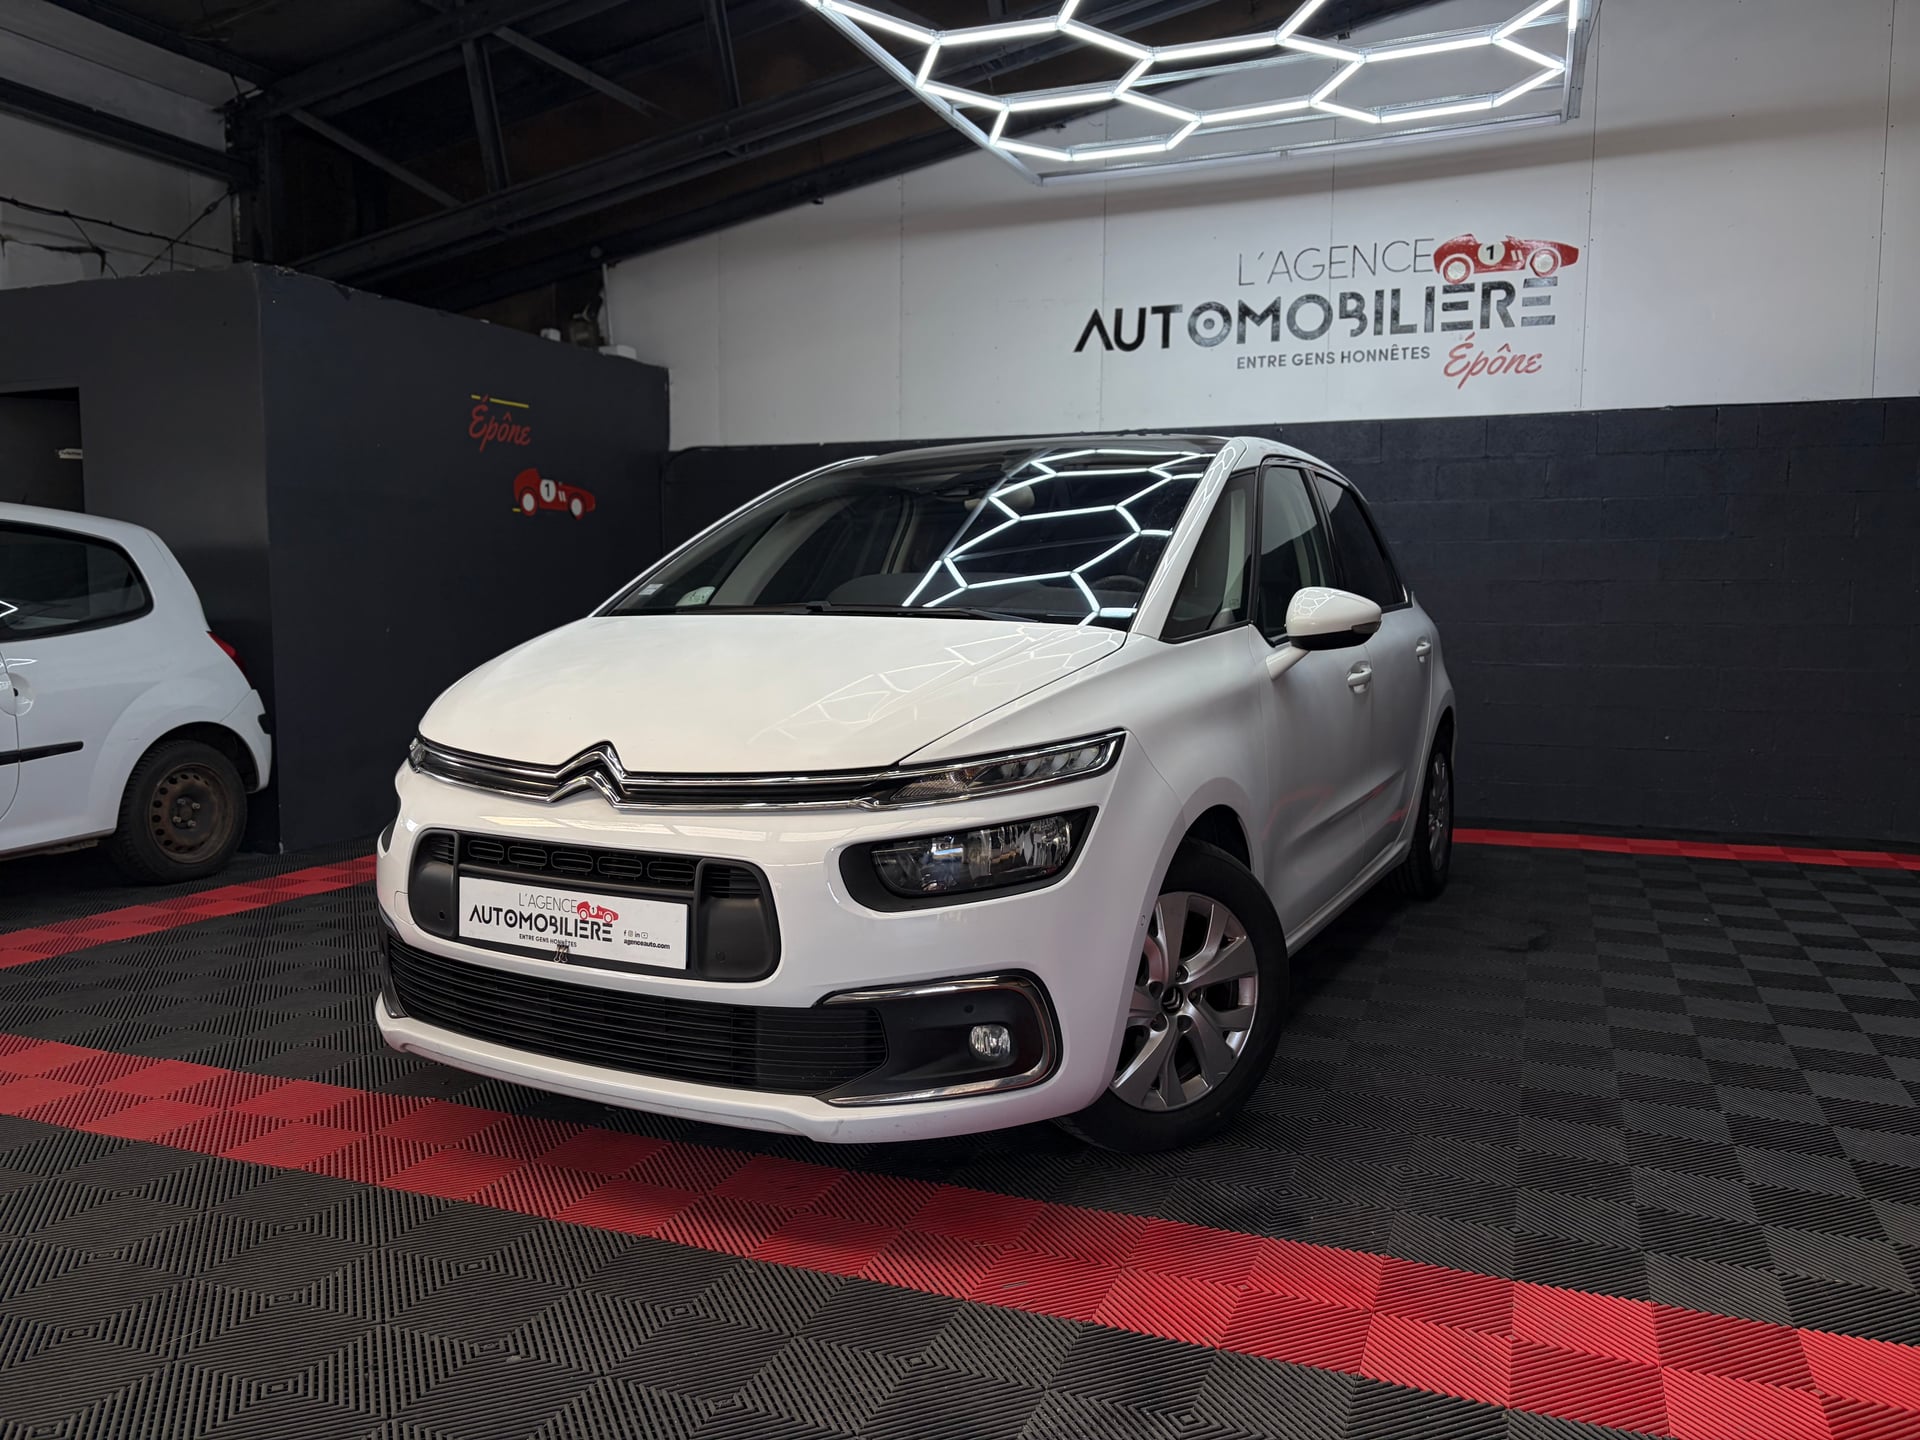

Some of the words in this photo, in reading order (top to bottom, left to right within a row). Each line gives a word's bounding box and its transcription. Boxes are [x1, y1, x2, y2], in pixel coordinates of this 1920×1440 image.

[1238, 237, 1435, 287] L'AGENCE
[1485, 244, 1496, 261] 1
[1236, 353, 1288, 370] ENTRE
[1291, 352, 1336, 367] GENS
[1340, 343, 1431, 365] HONNÊTES
[1442, 332, 1543, 390] Épône
[468, 393, 532, 453] Épône
[518, 892, 578, 915] L'AGENCE
[519, 933, 535, 941] ENTRE
[535, 935, 550, 943] GENS
[623, 939, 671, 950] agenceauto.com
